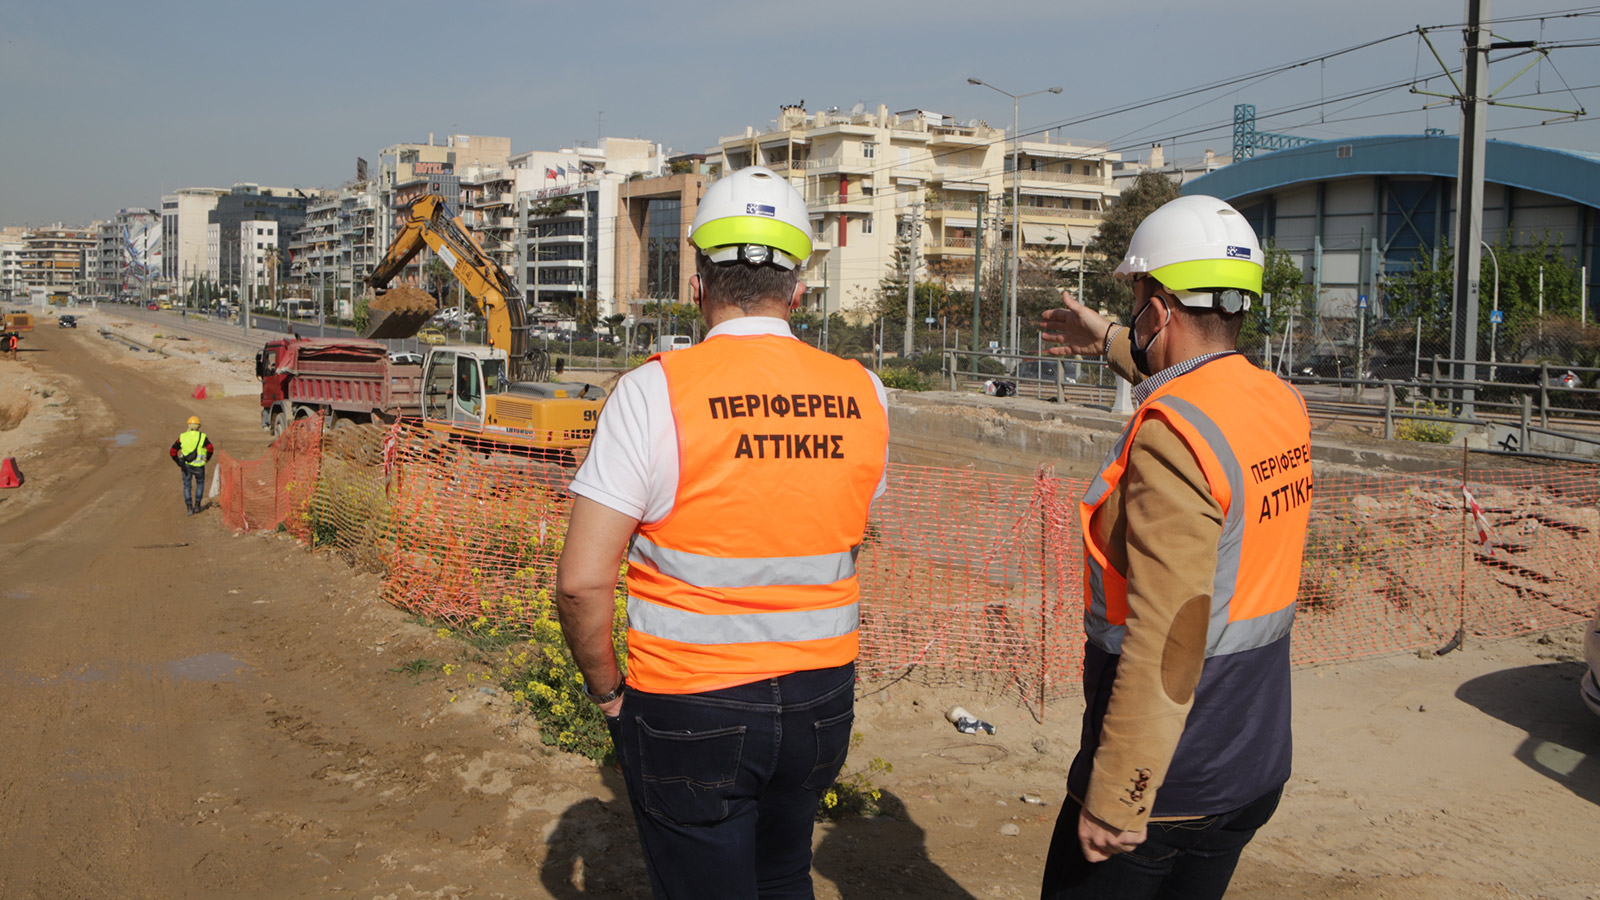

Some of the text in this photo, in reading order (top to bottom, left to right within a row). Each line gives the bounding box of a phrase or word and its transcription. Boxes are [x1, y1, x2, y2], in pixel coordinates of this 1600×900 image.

[415, 162, 444, 174] HOTEL
[583, 410, 597, 421] 91
[708, 394, 862, 419] ΠΕΡΙΦΕΡΕΙΑ
[734, 433, 845, 459] ΑΤΤΙΚΗΣ
[1250, 443, 1310, 484] ΠΕΡΙΦΕΡΕΙ
[1259, 475, 1313, 524] ΑΤΤΙΚΗ
